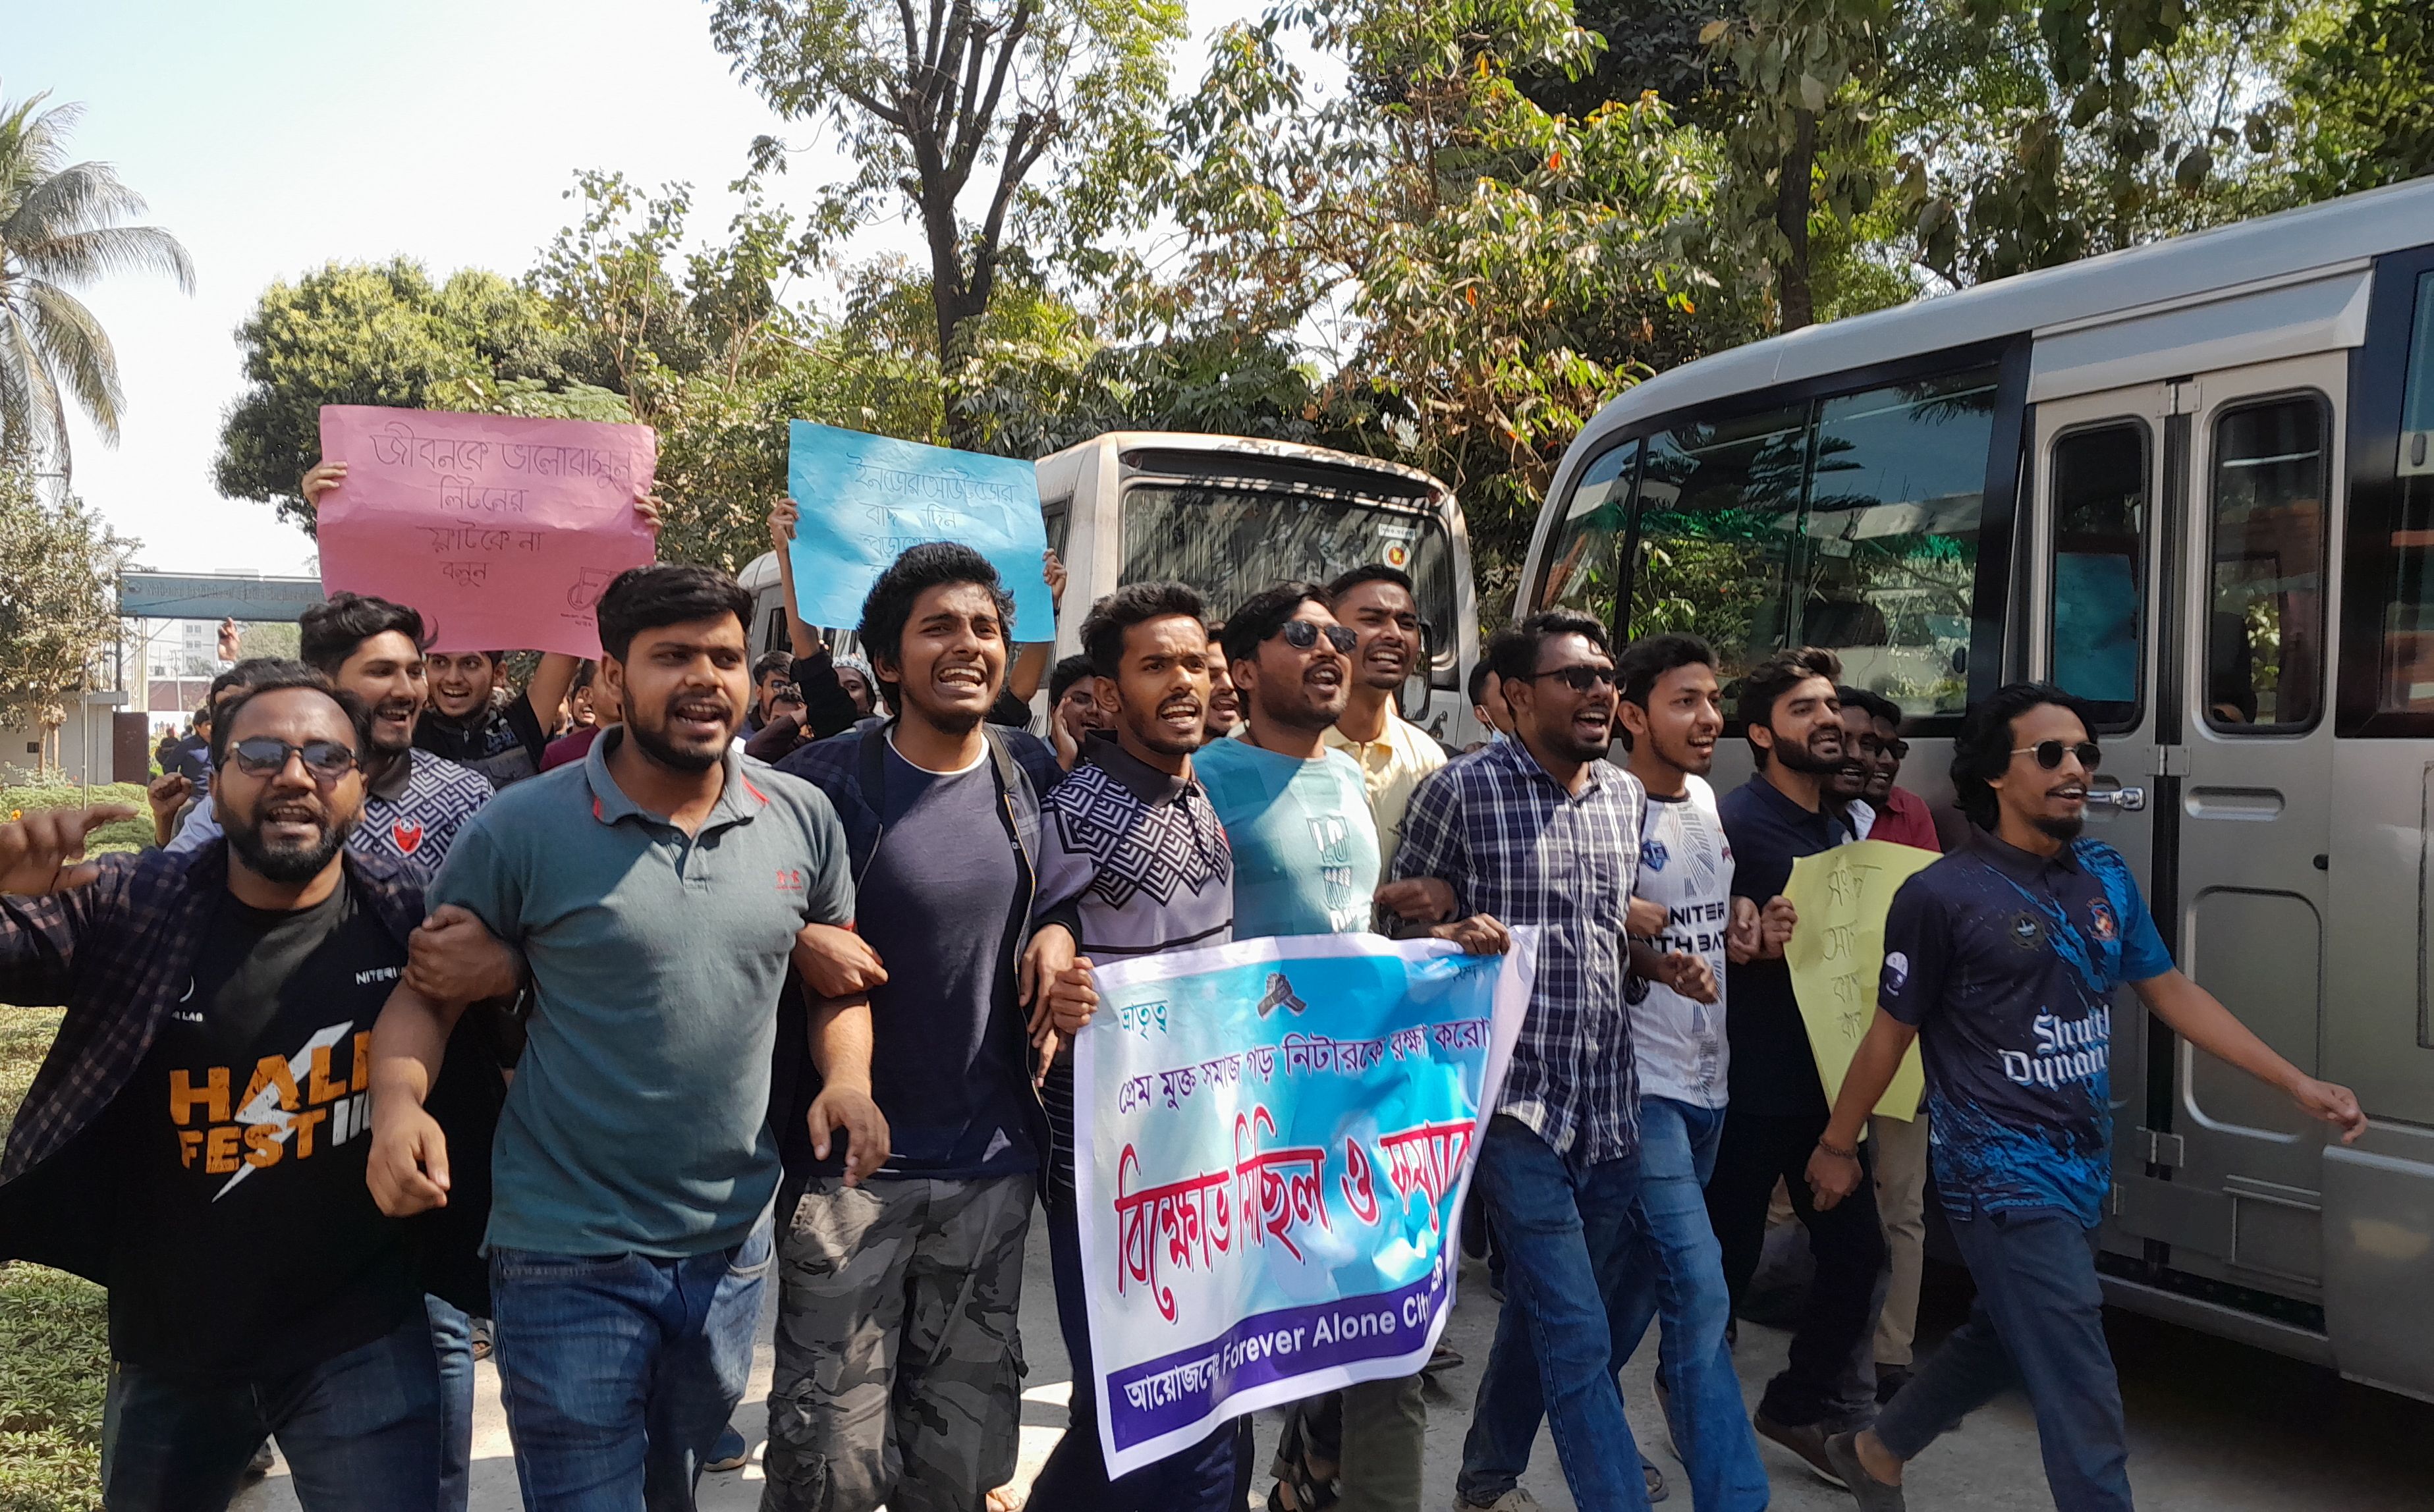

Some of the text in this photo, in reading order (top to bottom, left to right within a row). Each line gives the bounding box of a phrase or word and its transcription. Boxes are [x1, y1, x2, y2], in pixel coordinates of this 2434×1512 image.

[370, 421, 492, 472] জীবনকে
[427, 473, 530, 513] লিটনের
[920, 503, 971, 529] দিন
[517, 531, 546, 552] না
[439, 560, 494, 587] বলুন
[1670, 901, 1726, 929] NITER
[1697, 930, 1727, 952] BAT
[1119, 1074, 1153, 1114] প্রেম
[1158, 1066, 1198, 1112] মুক্ত
[1198, 1052, 1242, 1092] সমাজ
[1282, 1031, 1386, 1075] নিটারকে
[1389, 1022, 1429, 1062] রক্ষা
[1432, 1015, 1491, 1052] করো
[178, 1108, 327, 1174] FEST
[1114, 1142, 1231, 1325] বিক্ষোভ
[1234, 1106, 1334, 1265] মিছিল
[1341, 1135, 1381, 1226] ও
[1222, 1324, 1306, 1376] Forever
[1312, 1310, 1396, 1349] Alone
